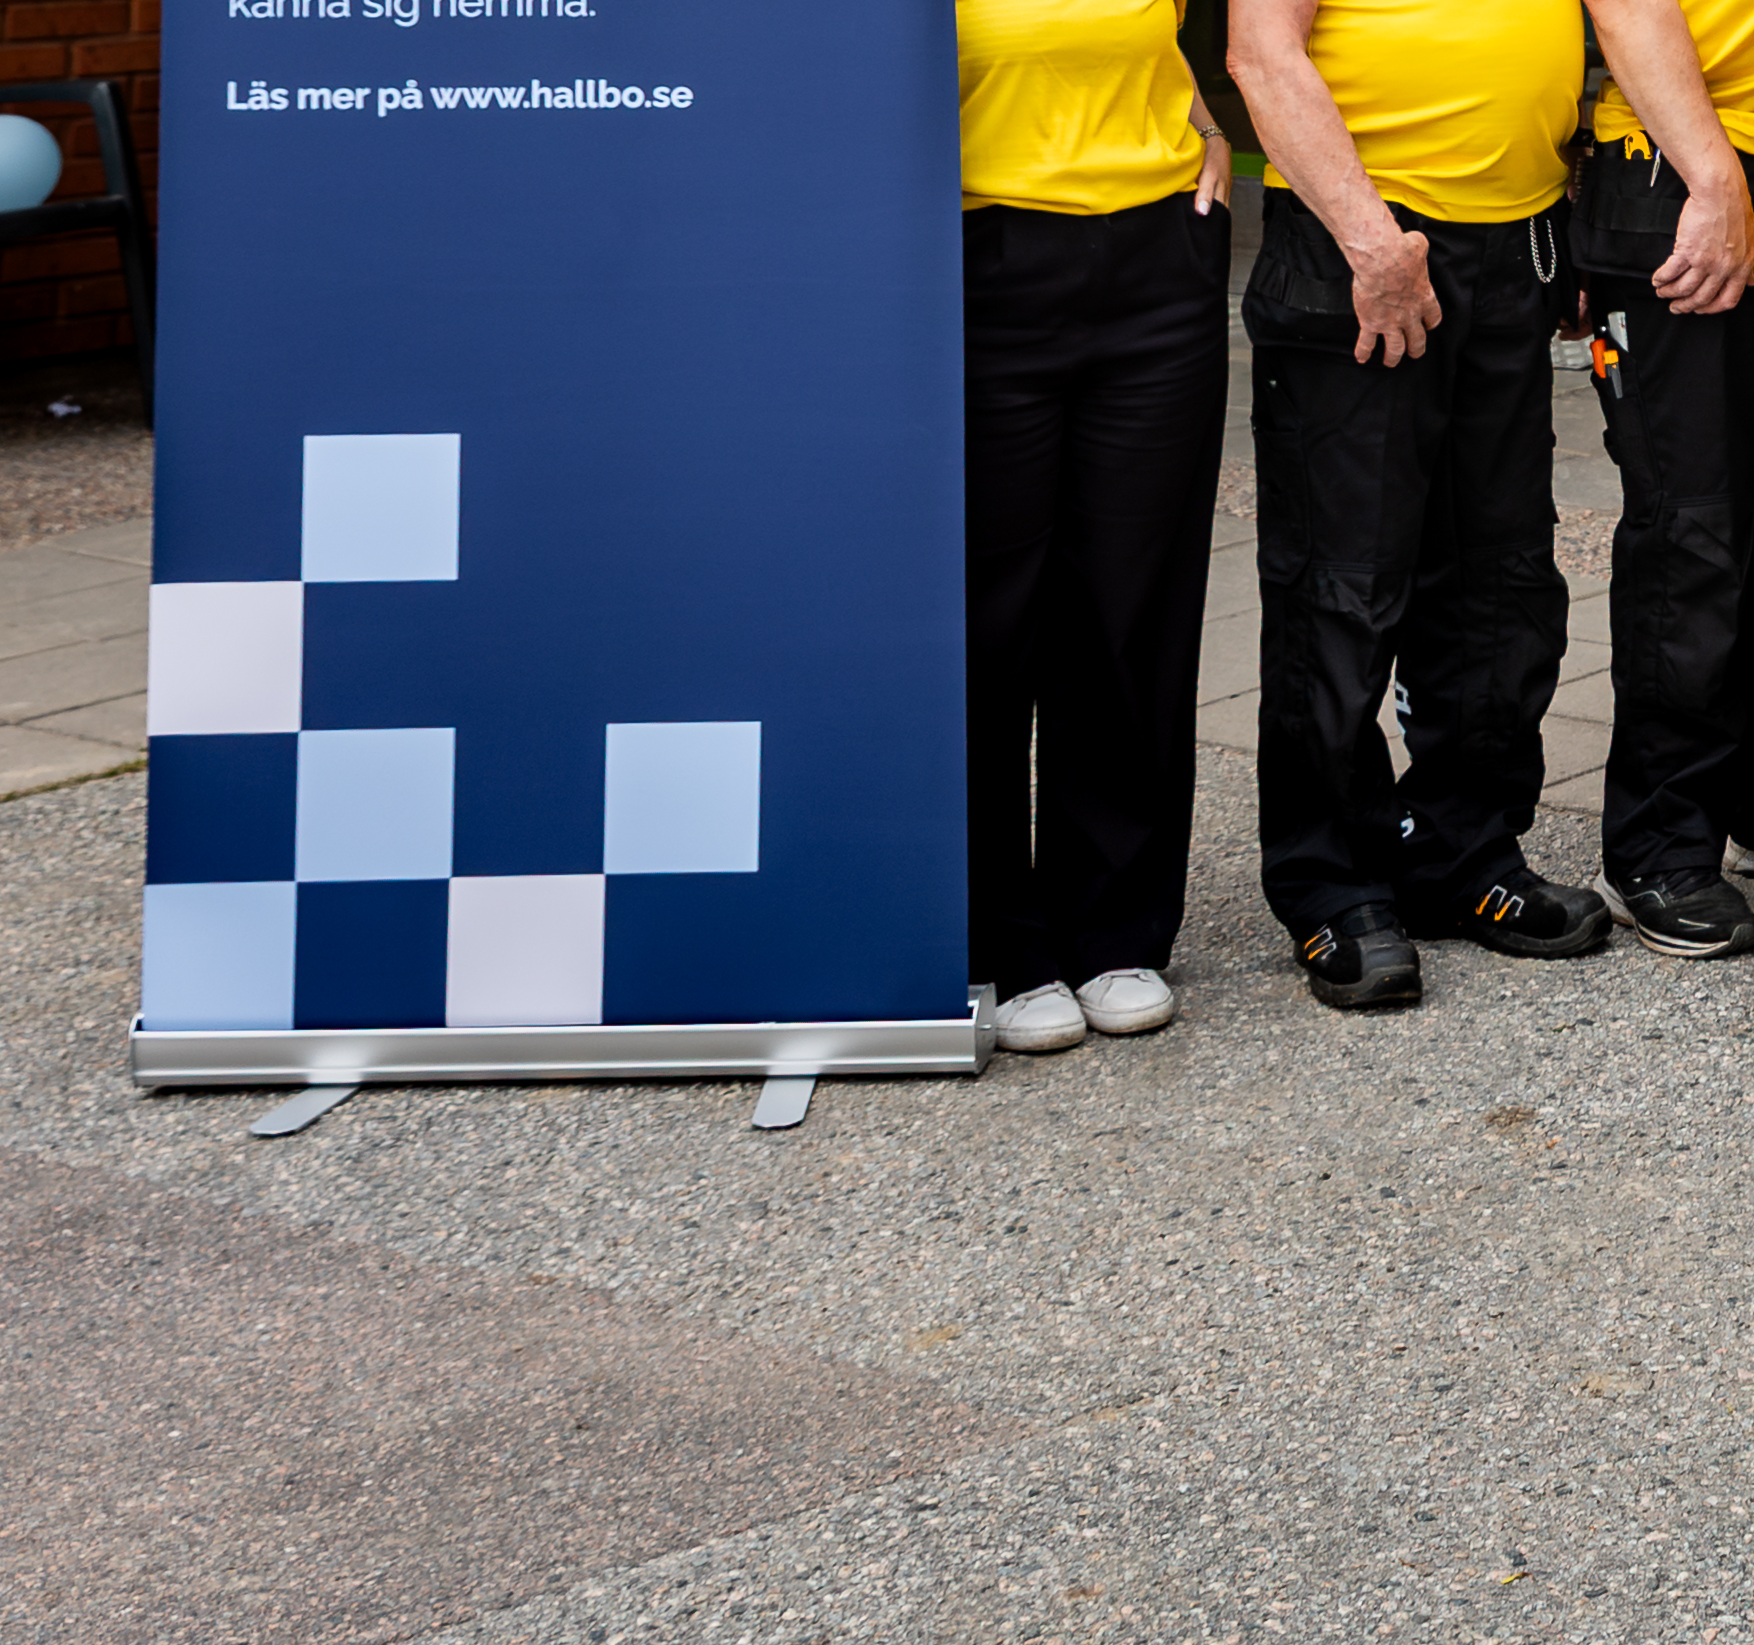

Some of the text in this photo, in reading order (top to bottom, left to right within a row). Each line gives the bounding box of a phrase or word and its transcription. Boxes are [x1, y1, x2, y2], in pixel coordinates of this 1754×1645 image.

[227, 79, 694, 117] Läs mer på www.hallbo.se
